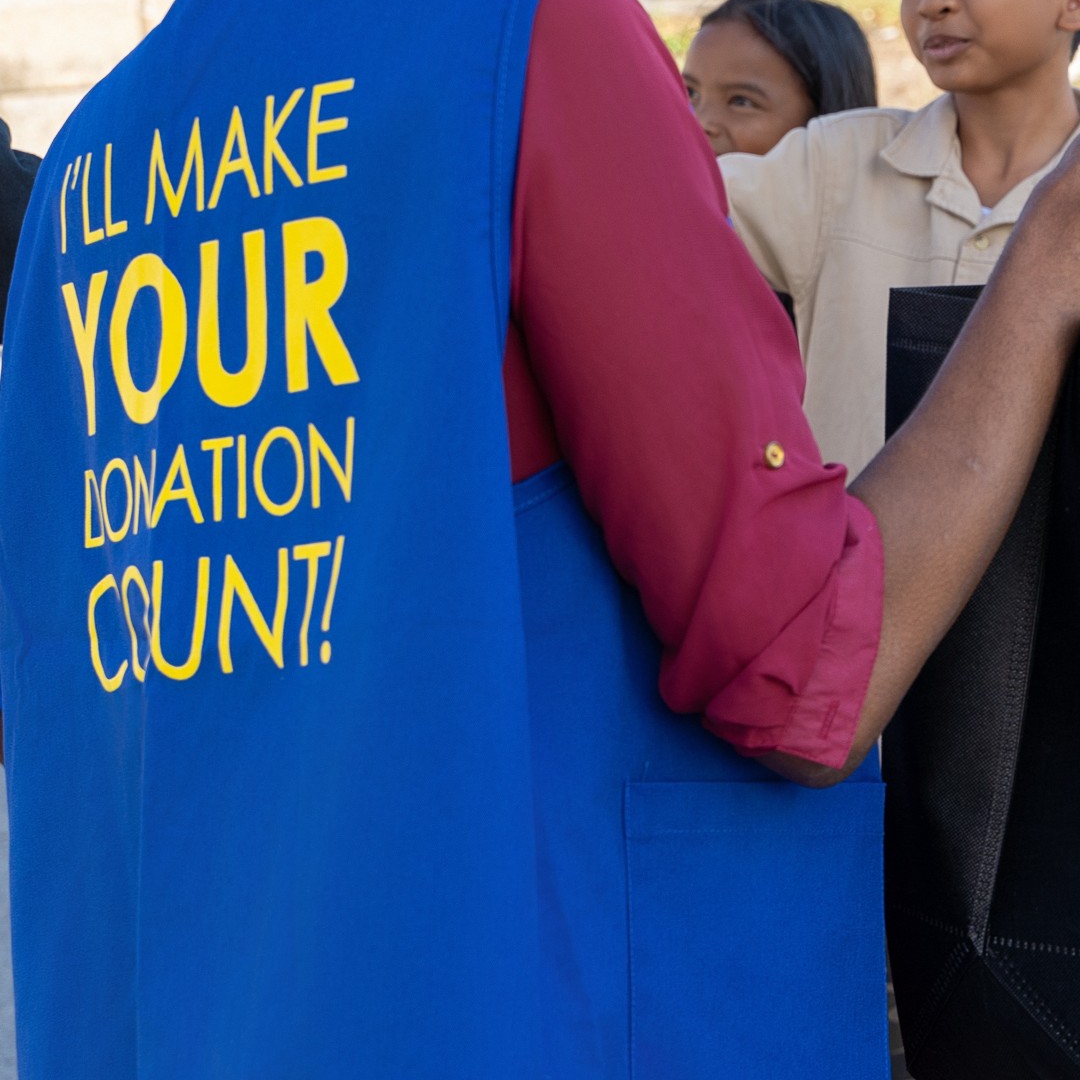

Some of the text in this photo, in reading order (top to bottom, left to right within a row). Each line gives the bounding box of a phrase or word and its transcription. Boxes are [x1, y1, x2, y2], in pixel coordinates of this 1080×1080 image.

[61, 78, 355, 254] I'LL MAKE
[61, 216, 361, 437] YOUR
[84, 417, 355, 549] DONATION
[88, 536, 346, 692] COUNT!
